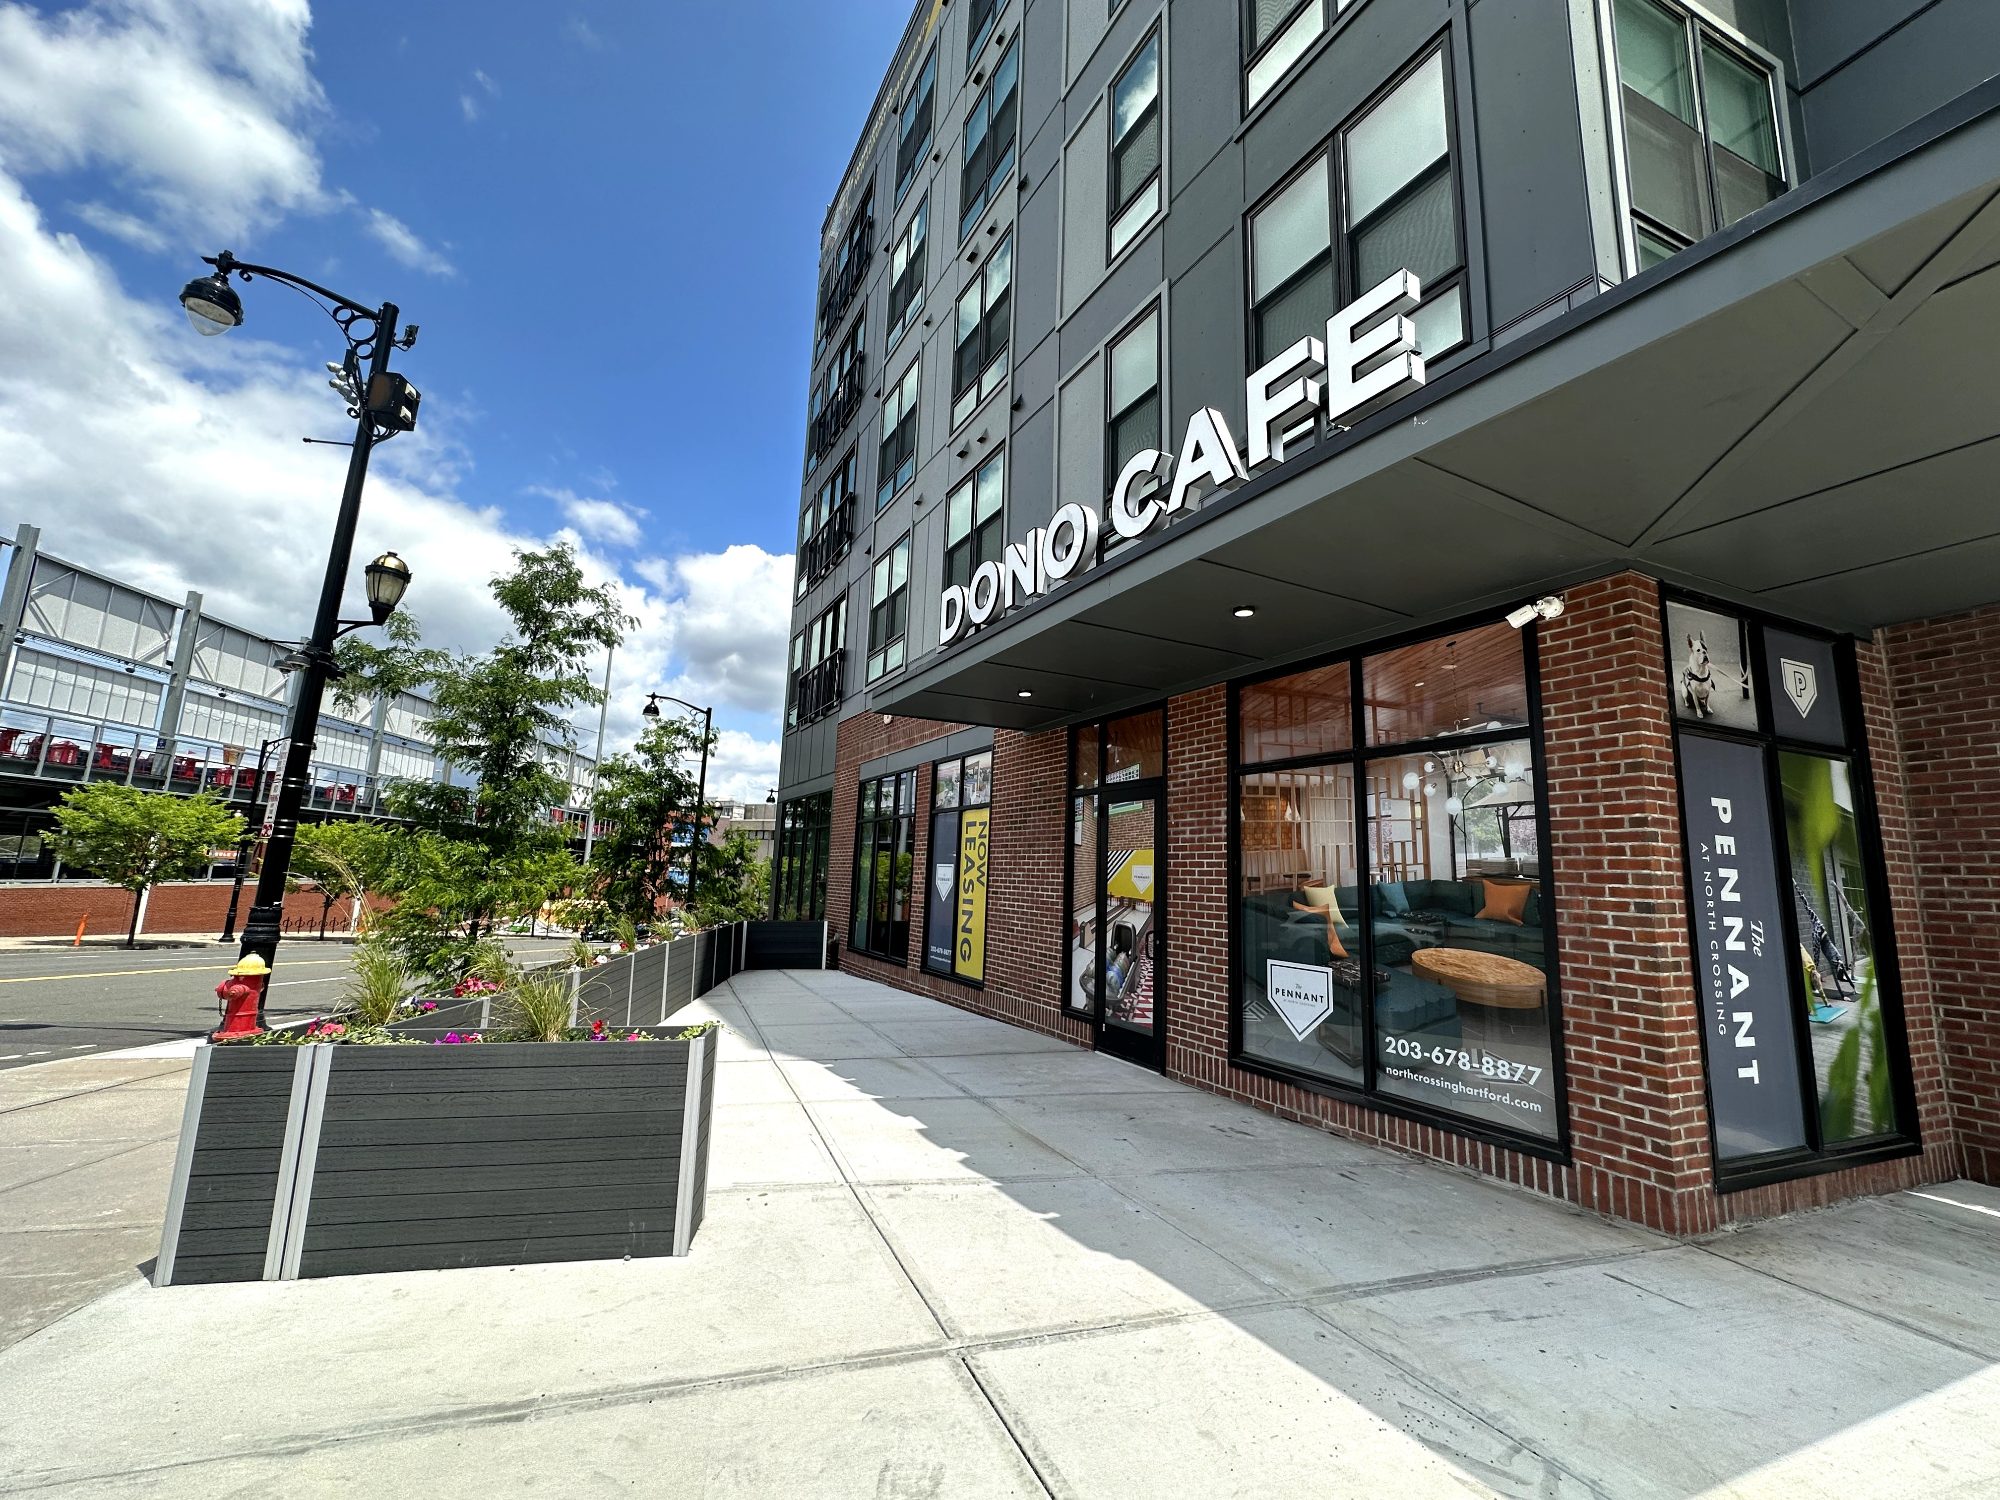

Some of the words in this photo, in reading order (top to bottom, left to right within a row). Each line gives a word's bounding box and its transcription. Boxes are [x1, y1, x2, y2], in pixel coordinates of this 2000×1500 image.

[938, 502, 1098, 653] DONO
[1111, 267, 1425, 541] CAFE
[1793, 670, 1807, 698] P
[976, 820, 988, 888] NOW
[1700, 842, 1710, 862] AT
[959, 820, 977, 963] LEASING
[1703, 871, 1717, 931] NORTH
[1710, 797, 1760, 1085] PENNANT
[1750, 920, 1765, 957] The
[1275, 987, 1324, 1004] PENNANT
[1710, 940, 1727, 1036] CROSSING
[1385, 1036, 1542, 1086] 203-678-8877
[1386, 1066, 1542, 1113] northcrossinghartford.com
